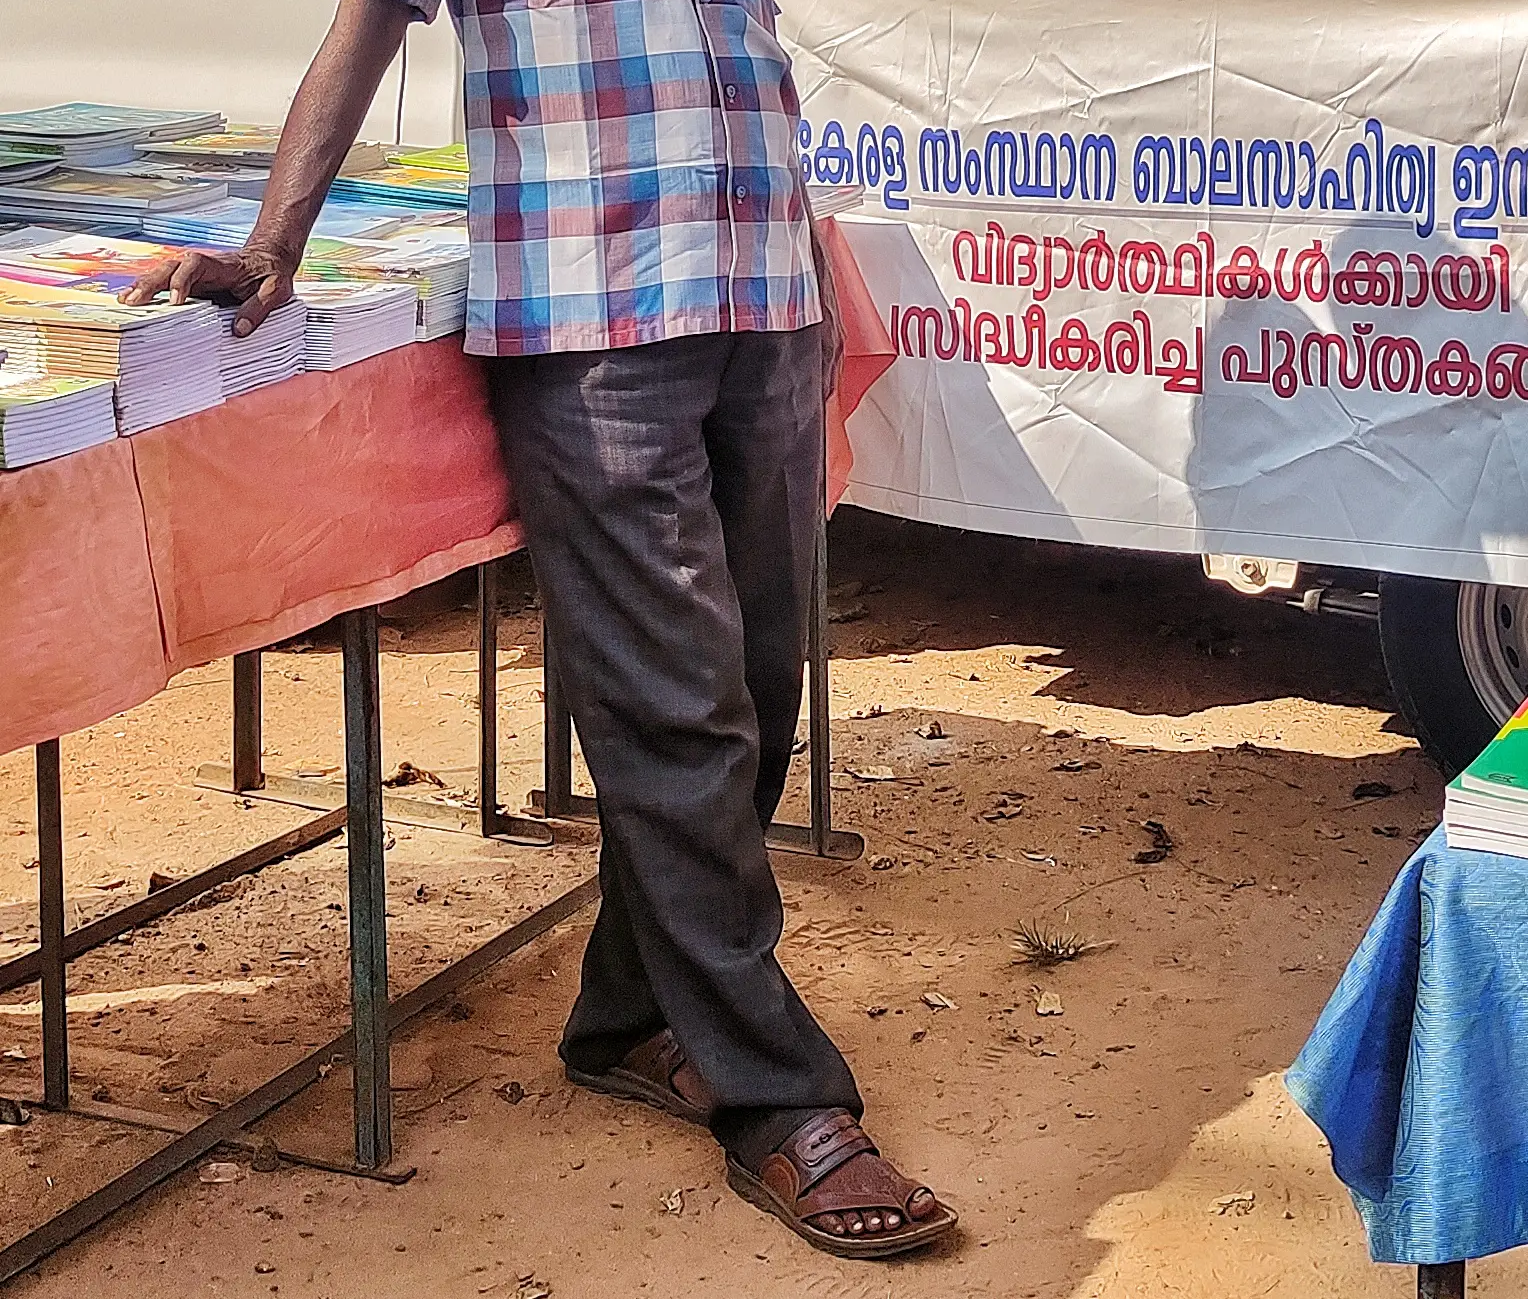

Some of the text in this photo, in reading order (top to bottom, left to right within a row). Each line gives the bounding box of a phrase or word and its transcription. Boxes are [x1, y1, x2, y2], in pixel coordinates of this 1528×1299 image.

[801, 119, 910, 211] കേരള
[919, 127, 1116, 202] സംസ്ഥാന
[1133, 119, 1436, 238] ബാലസാഹിത്യ
[951, 219, 1512, 313] വിദ്യാർത്ഥികൾക്കായി
